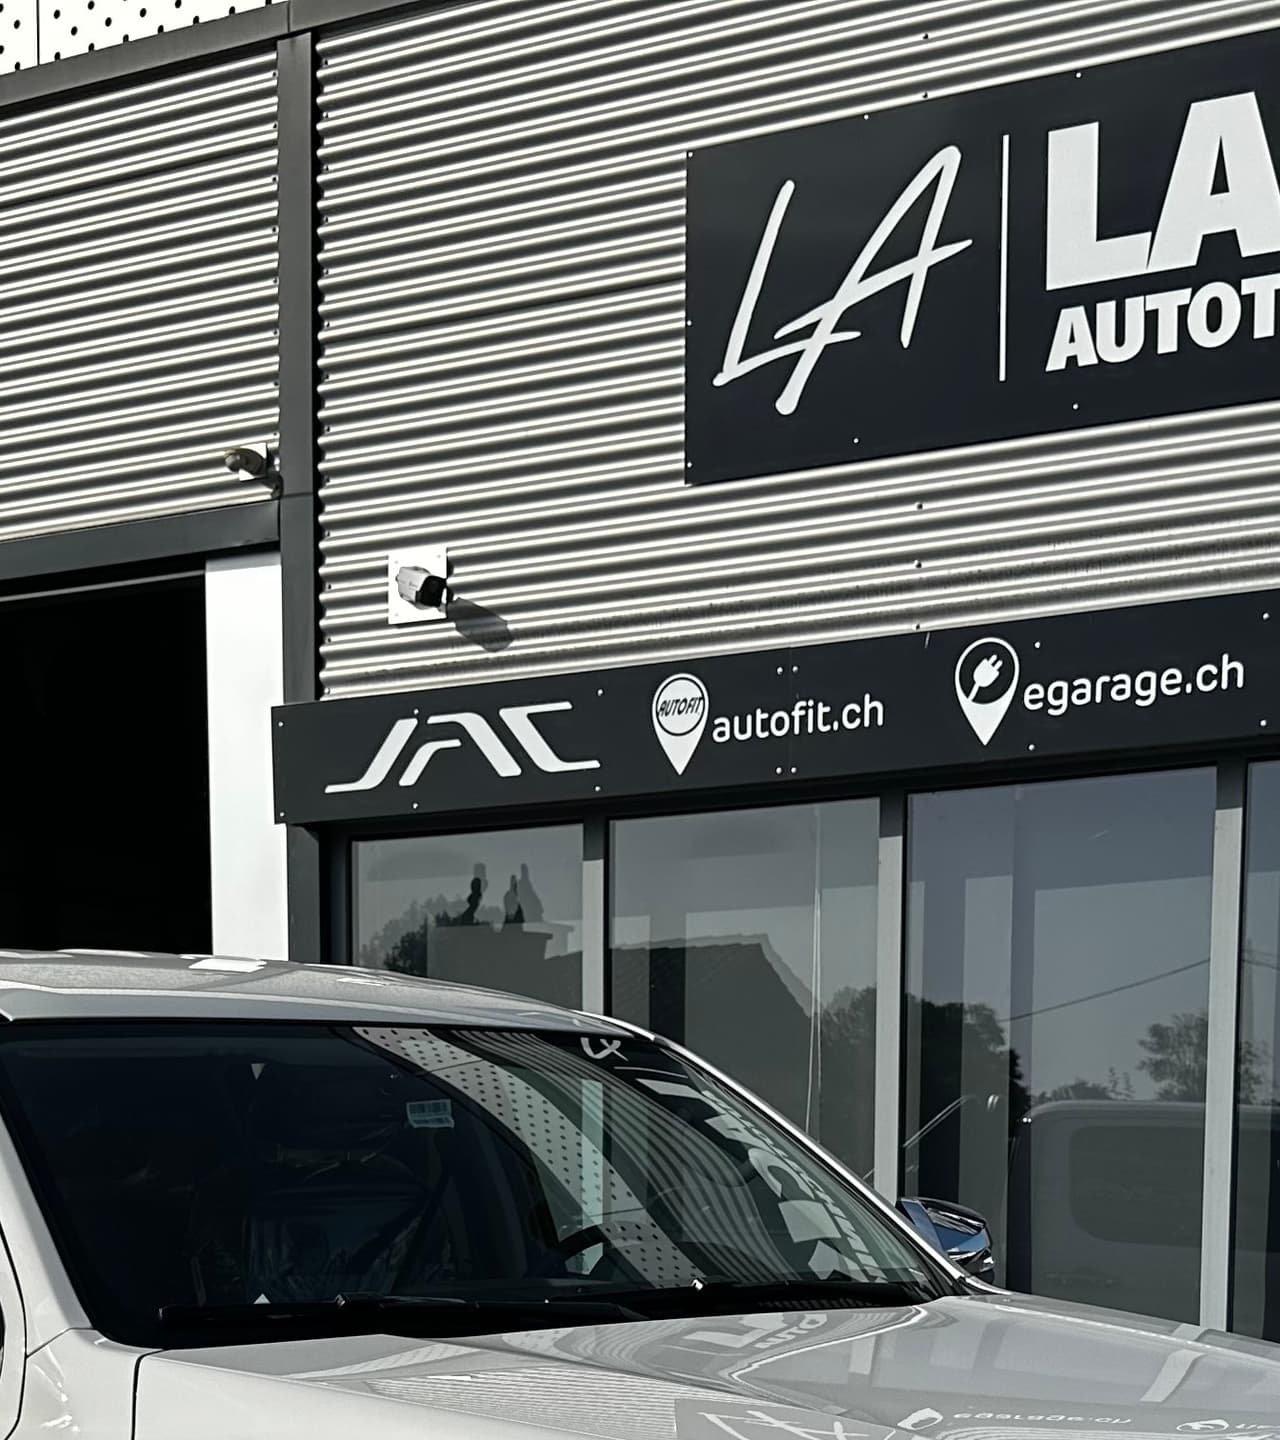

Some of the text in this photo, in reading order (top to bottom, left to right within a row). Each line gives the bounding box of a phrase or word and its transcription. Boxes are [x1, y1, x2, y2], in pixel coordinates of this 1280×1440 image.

[713, 145, 972, 415] LA
[659, 697, 703, 717] AUTOFIT
[1023, 653, 1245, 716] egarage.ch
[324, 701, 600, 793] JAC
[712, 693, 883, 743] autofit.ch
